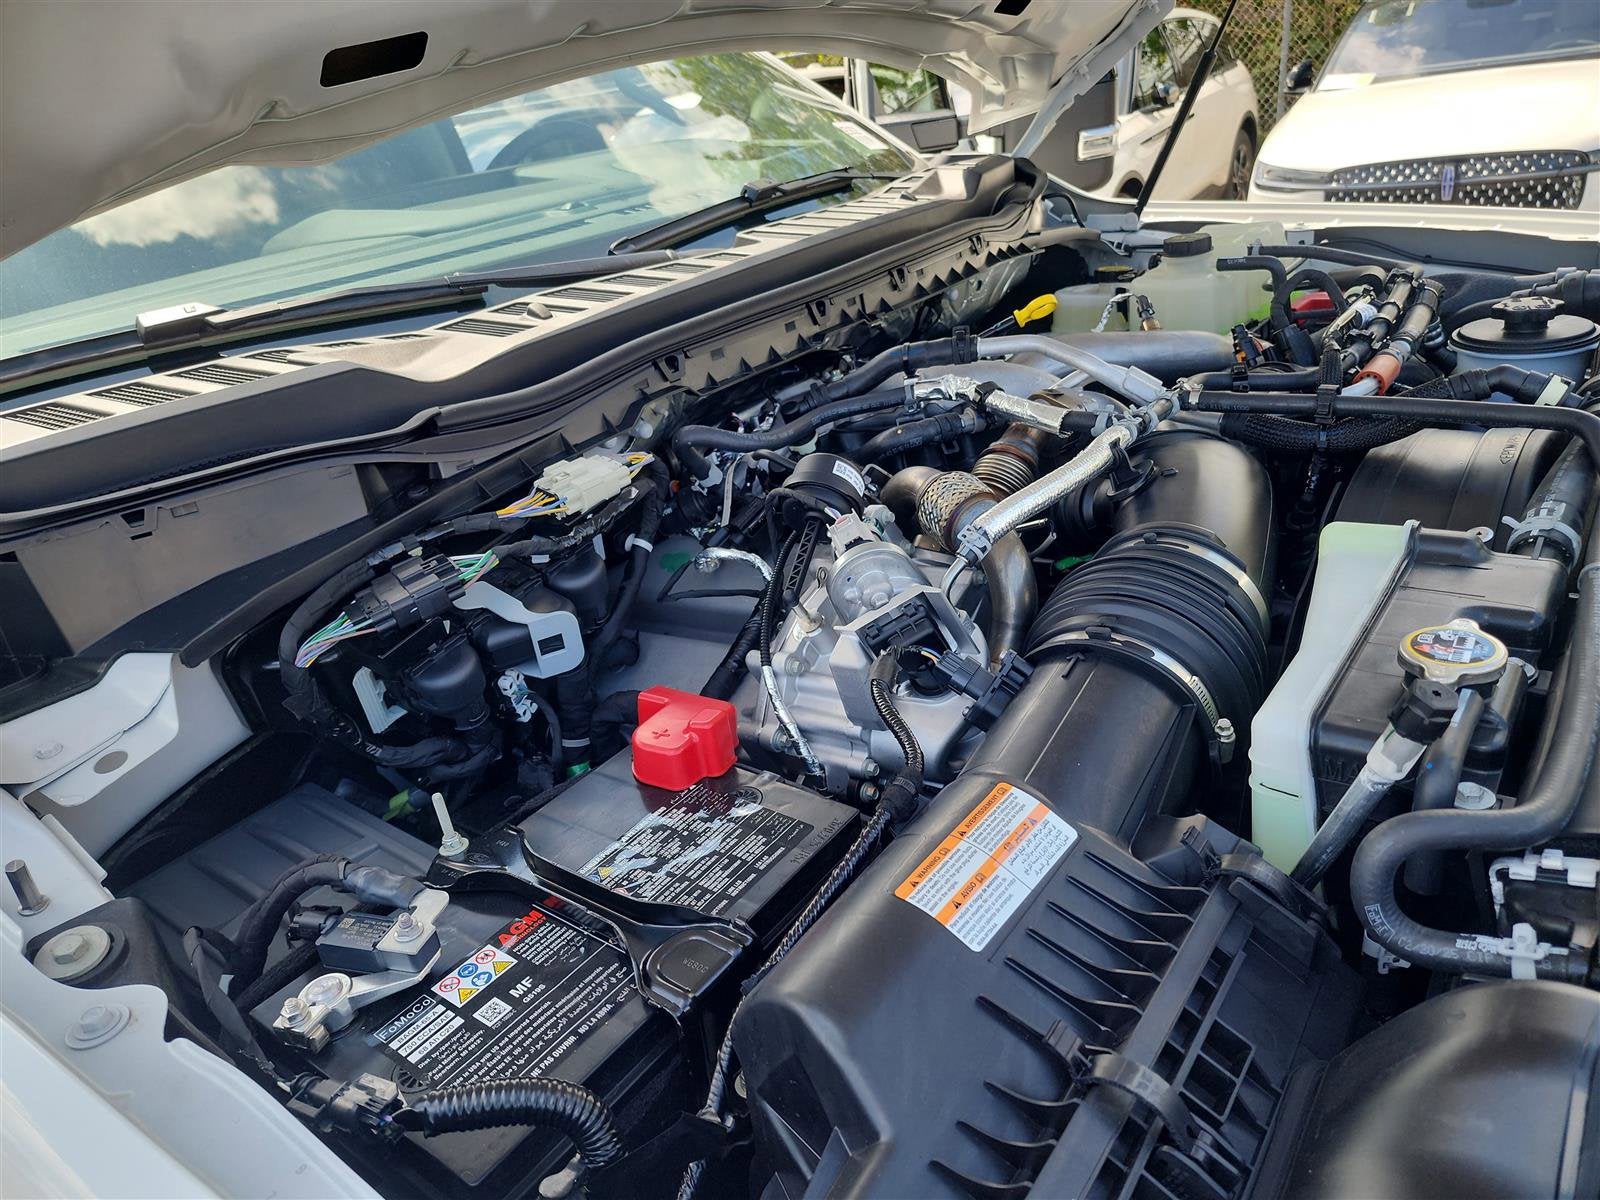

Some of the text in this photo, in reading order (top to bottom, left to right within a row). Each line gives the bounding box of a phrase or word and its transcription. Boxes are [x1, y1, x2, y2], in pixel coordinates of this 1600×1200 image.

[964, 793, 998, 828] AVERTISSEMENT
[916, 854, 940, 878] WARNING
[959, 880, 977, 898] AVISO
[495, 907, 543, 946] AGM
[508, 975, 537, 998] MF
[378, 996, 431, 1040] FoMoCo
[396, 1009, 438, 1043] BAGM-65-A
[402, 1012, 451, 1053] 750 CCA/SAE
[417, 1023, 455, 1055] 68 Ah C20
[427, 1028, 485, 1076] Ford Motor Company,
[459, 1049, 469, 1057] MI
[529, 1000, 615, 1078] NE PAS OUVRIR. NO LA ABRA.
[417, 1056, 433, 1069] Dist.
[447, 1075, 464, 1089] ade
[467, 1061, 481, 1072] USA
[478, 1051, 492, 1062] with
[490, 1045, 499, 1053] US
[497, 1036, 509, 1046] and
